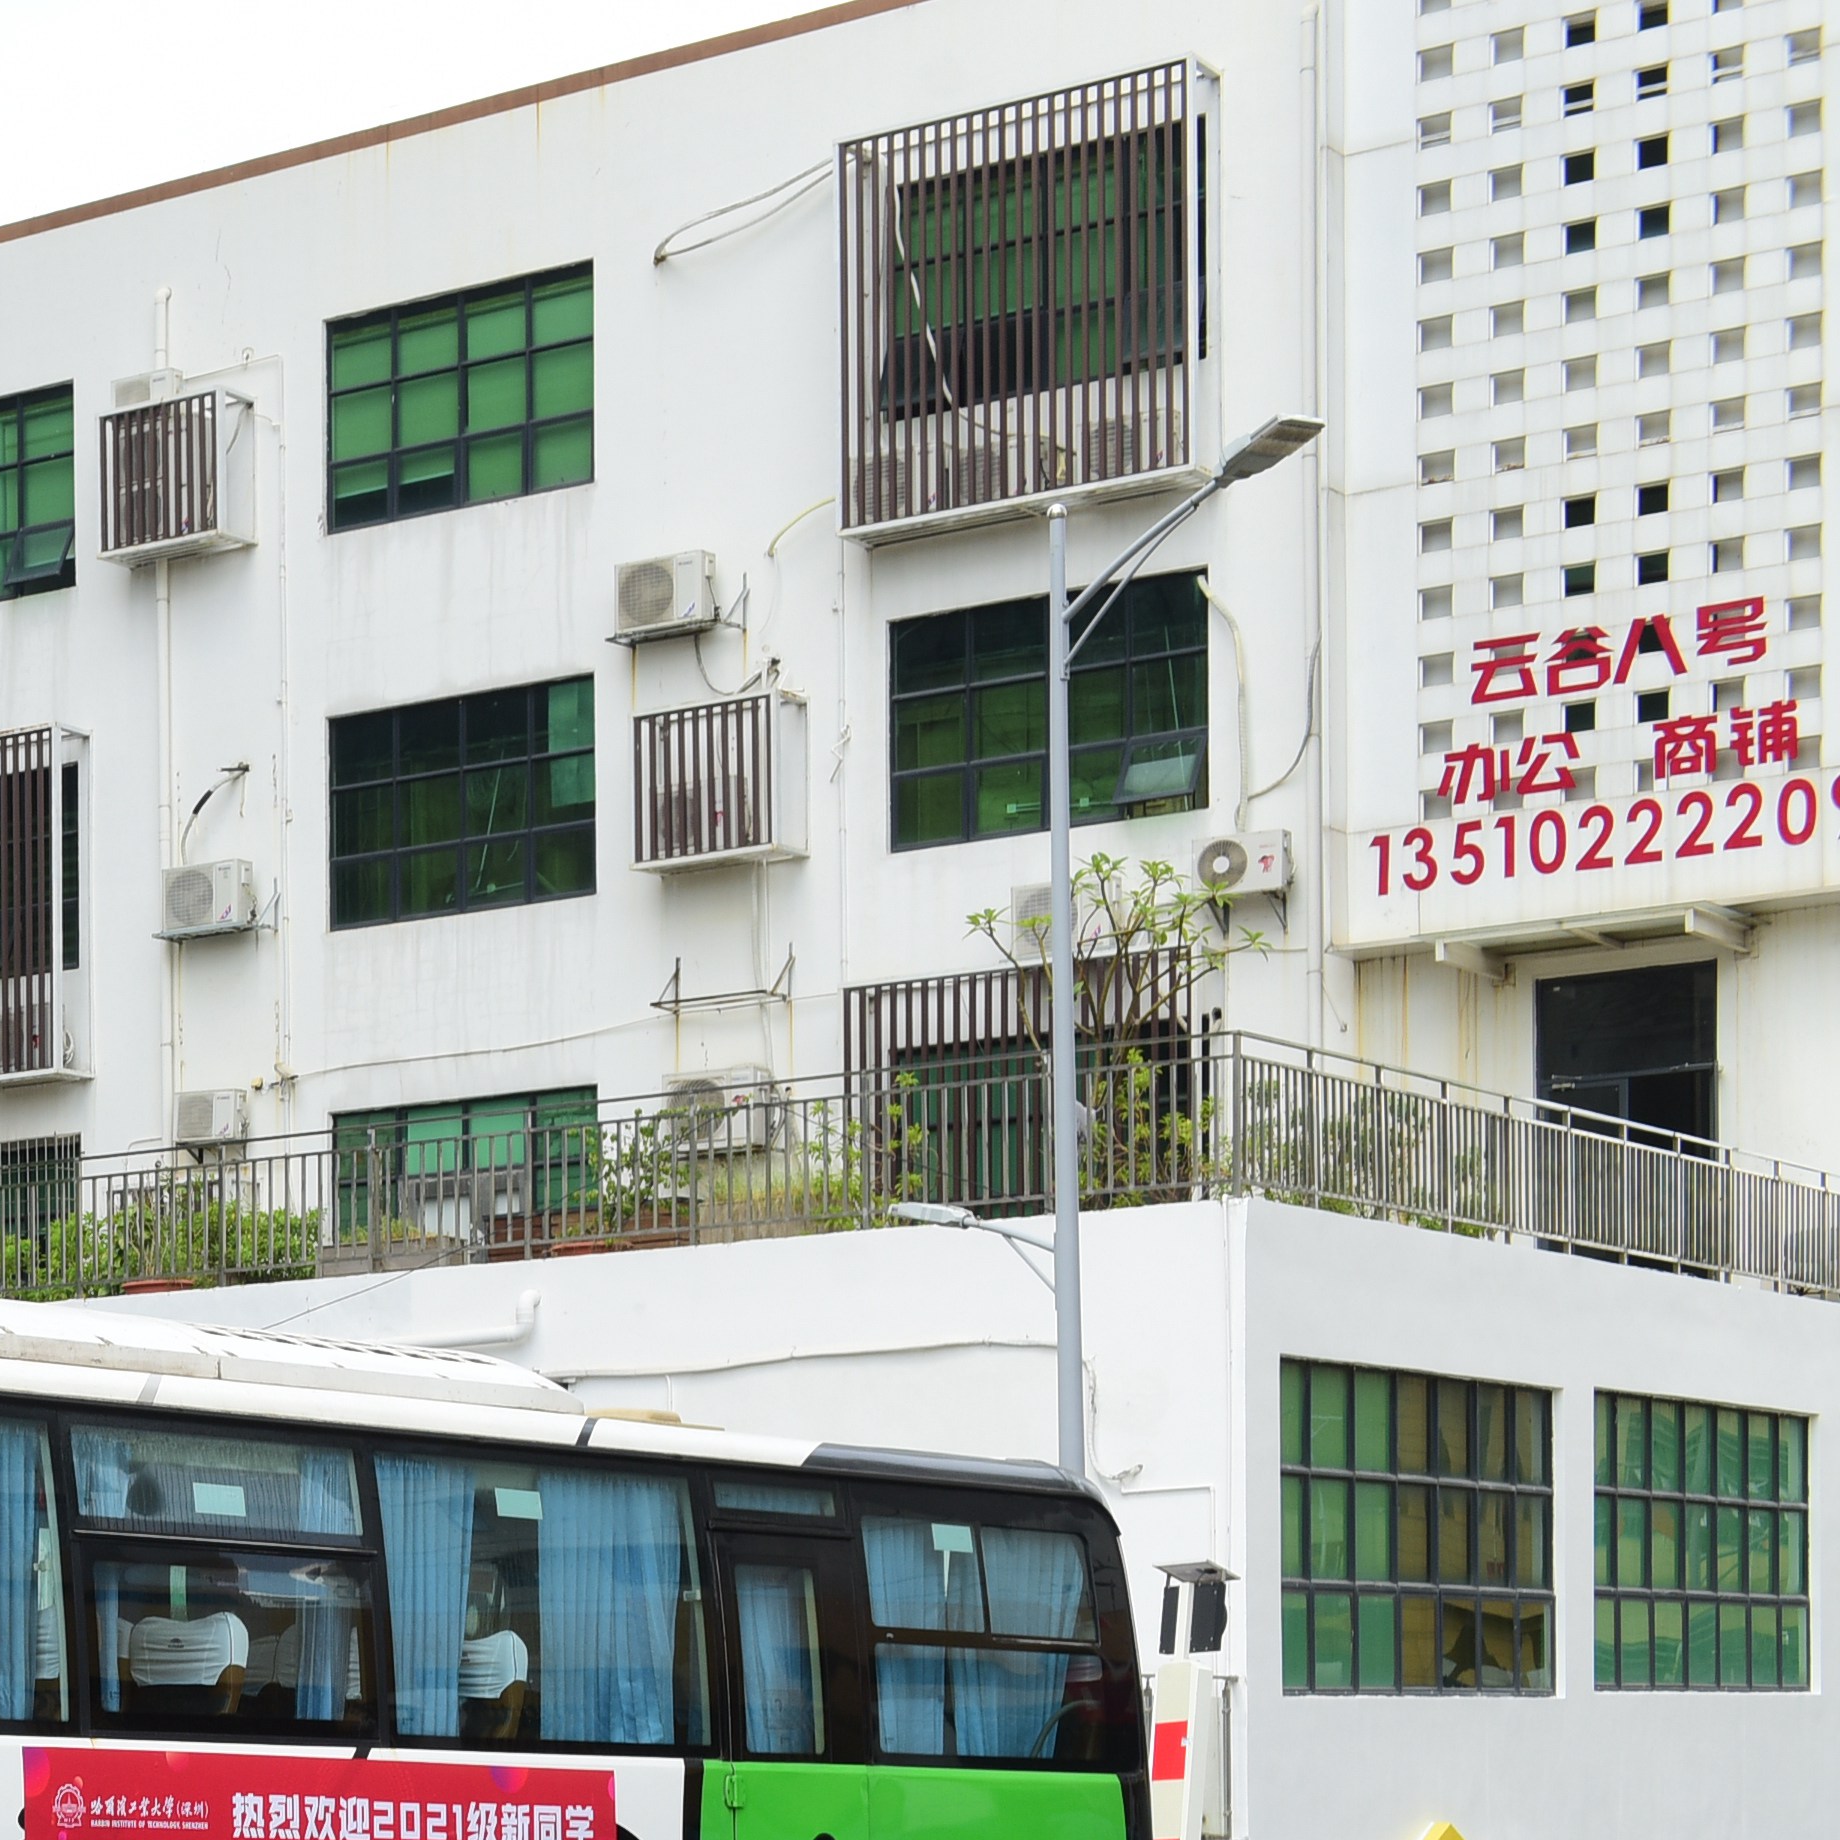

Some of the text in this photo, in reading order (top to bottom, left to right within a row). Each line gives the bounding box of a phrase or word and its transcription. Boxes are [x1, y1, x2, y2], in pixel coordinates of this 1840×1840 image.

[1471, 596, 1768, 705] 云谷八号
[1437, 699, 1799, 805] 办公 商铺
[1369, 774, 1840, 896] 1351022220
[90, 1819, 110, 1828] HARBIN
[111, 1820, 137, 1828] INSTITUTE
[138, 1820, 146, 1829] OF
[182, 1821, 209, 1830] SHENZHEN
